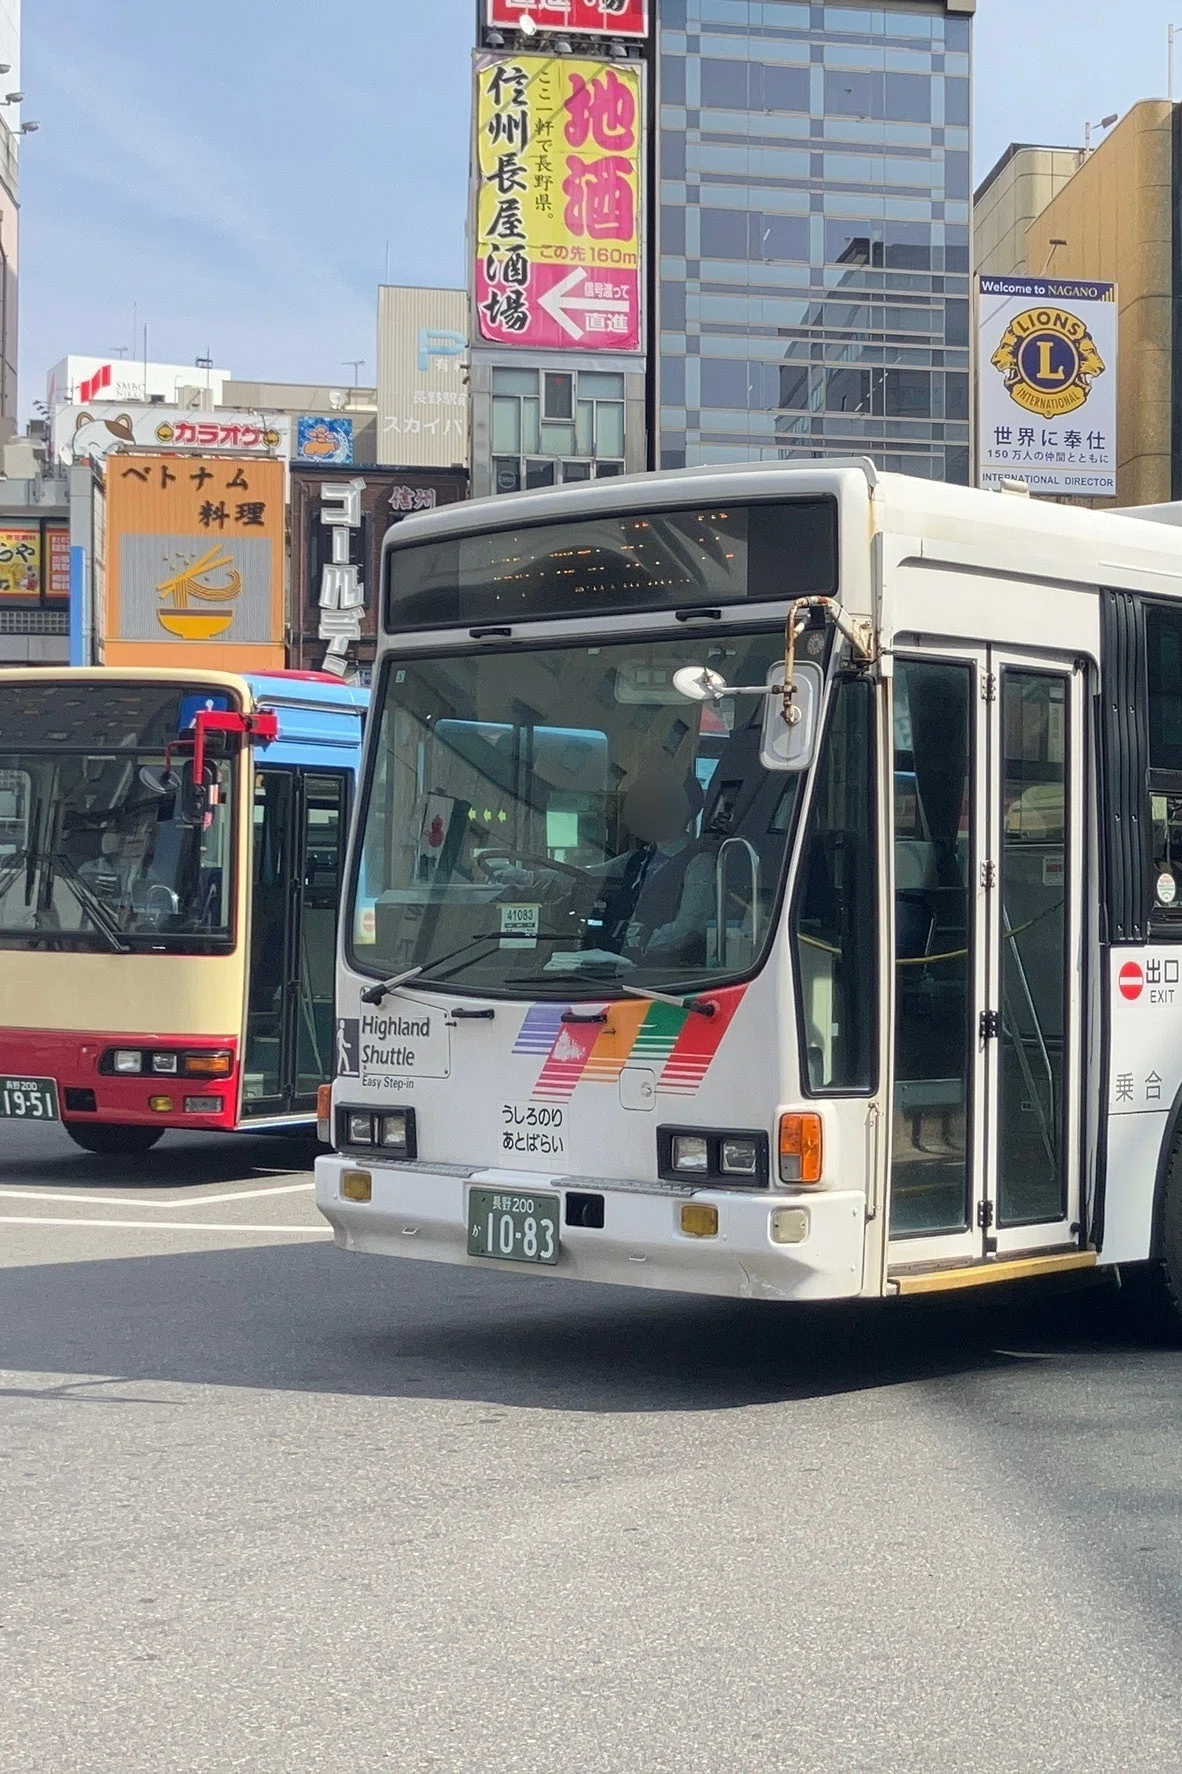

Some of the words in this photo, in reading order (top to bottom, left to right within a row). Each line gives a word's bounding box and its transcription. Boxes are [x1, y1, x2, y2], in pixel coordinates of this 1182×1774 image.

[562, 69, 638, 242] 地酒
[482, 66, 530, 333] 信州長屋酒場
[540, 246, 586, 261] この先
[590, 247, 637, 264] 160m
[584, 281, 630, 298] 信号渡って
[981, 280, 1032, 294] Welcome
[1034, 284, 1046, 295] to
[1047, 285, 1098, 297] NAGANO
[585, 312, 629, 333] 直進
[1015, 311, 1081, 337] LIONS
[1036, 341, 1065, 380] L
[1016, 387, 1081, 410] INTERNATIONAL
[174, 421, 264, 448] カラオケ
[993, 426, 1106, 450] 世界に奉仕
[121, 465, 249, 491] ベトナム
[1064, 476, 1114, 487] DIRECTOR
[388, 484, 437, 510] 信州
[199, 500, 266, 529] 料理
[507, 909, 534, 921] 41083
[1146, 958, 1179, 984] 出口
[1150, 990, 1175, 1003] EXIT
[361, 1015, 430, 1041] Highland
[361, 1044, 415, 1066] Shuttle
[362, 1075, 382, 1090] Easy
[383, 1076, 415, 1092] Step-in
[1115, 1069, 1162, 1102] 乗合
[502, 1104, 563, 1127] うしろのり
[502, 1131, 564, 1153] あとばらい
[487, 1212, 555, 1259] 10-83
